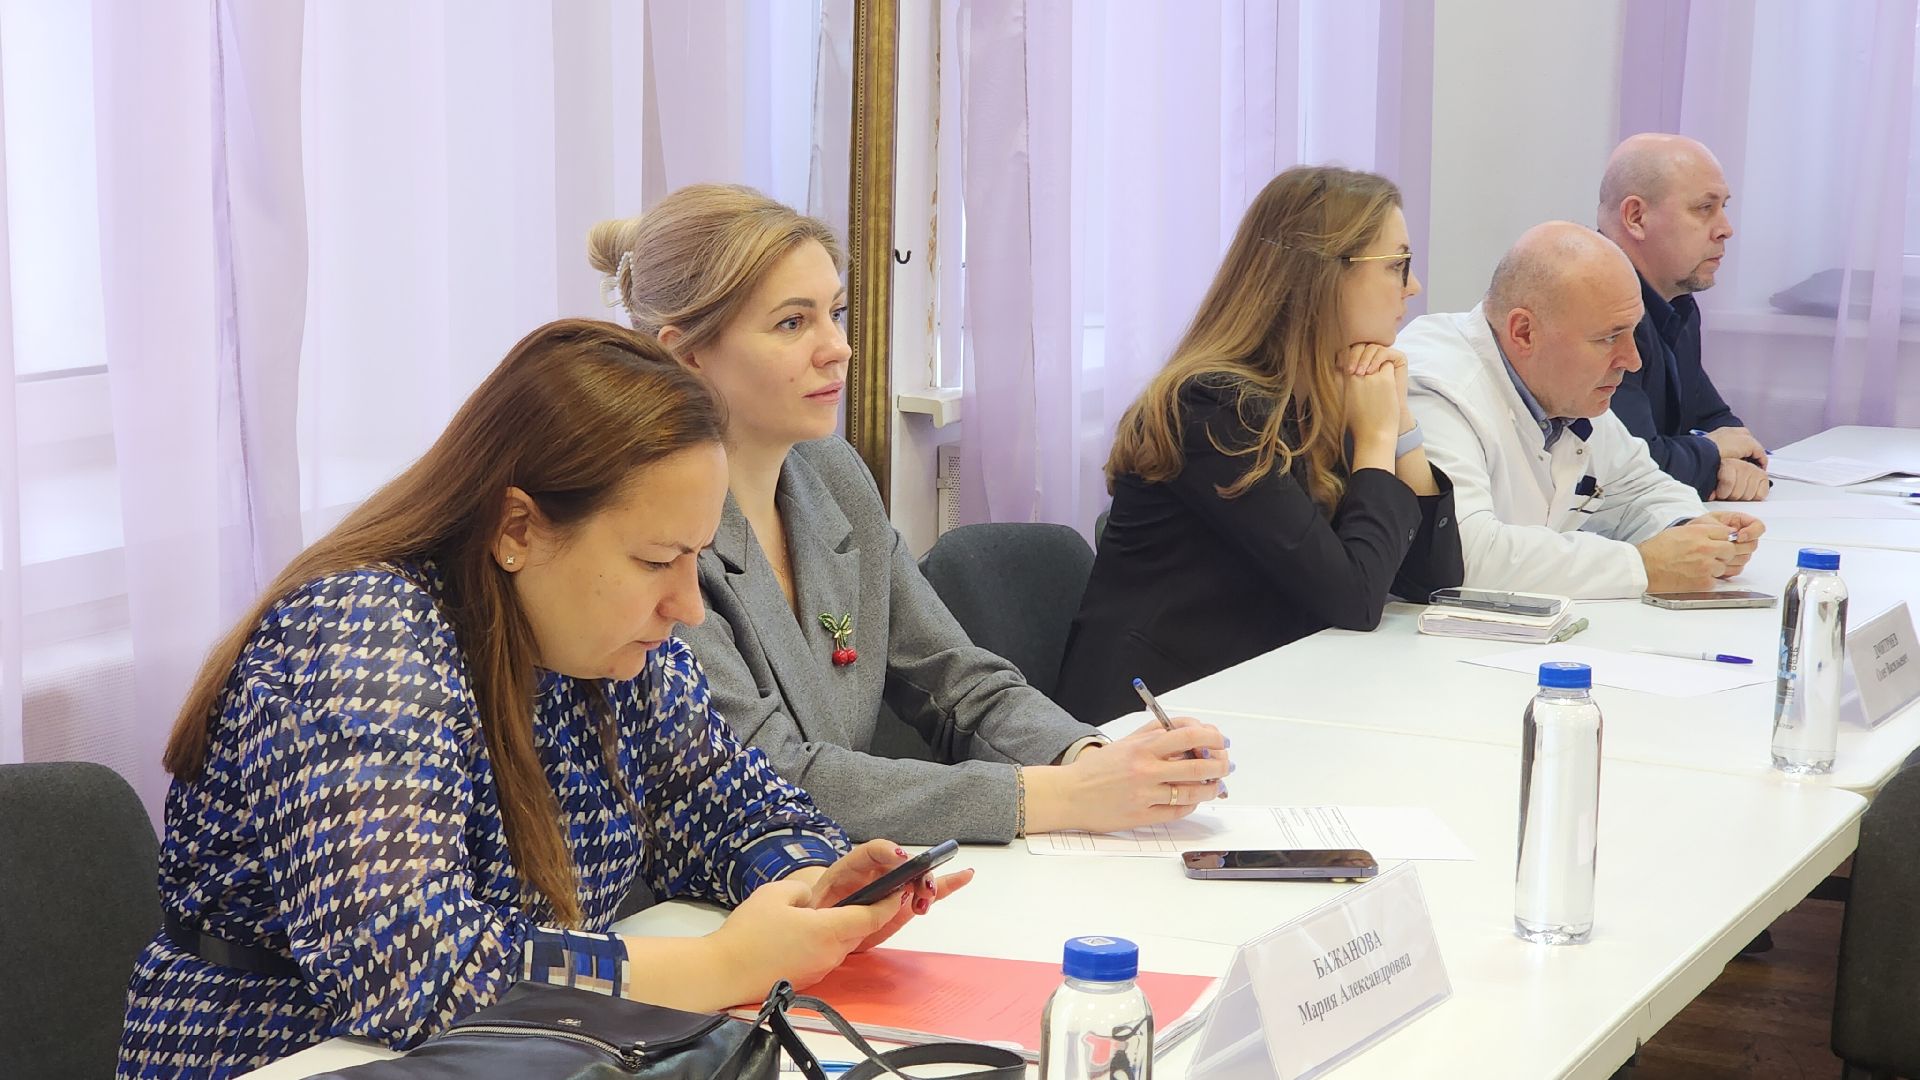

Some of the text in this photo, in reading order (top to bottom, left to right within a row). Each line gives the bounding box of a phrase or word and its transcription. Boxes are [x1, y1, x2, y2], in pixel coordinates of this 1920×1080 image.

[1312, 929, 1383, 980] БАЖАНОВА
[1297, 952, 1412, 1025] Мария Александровна
